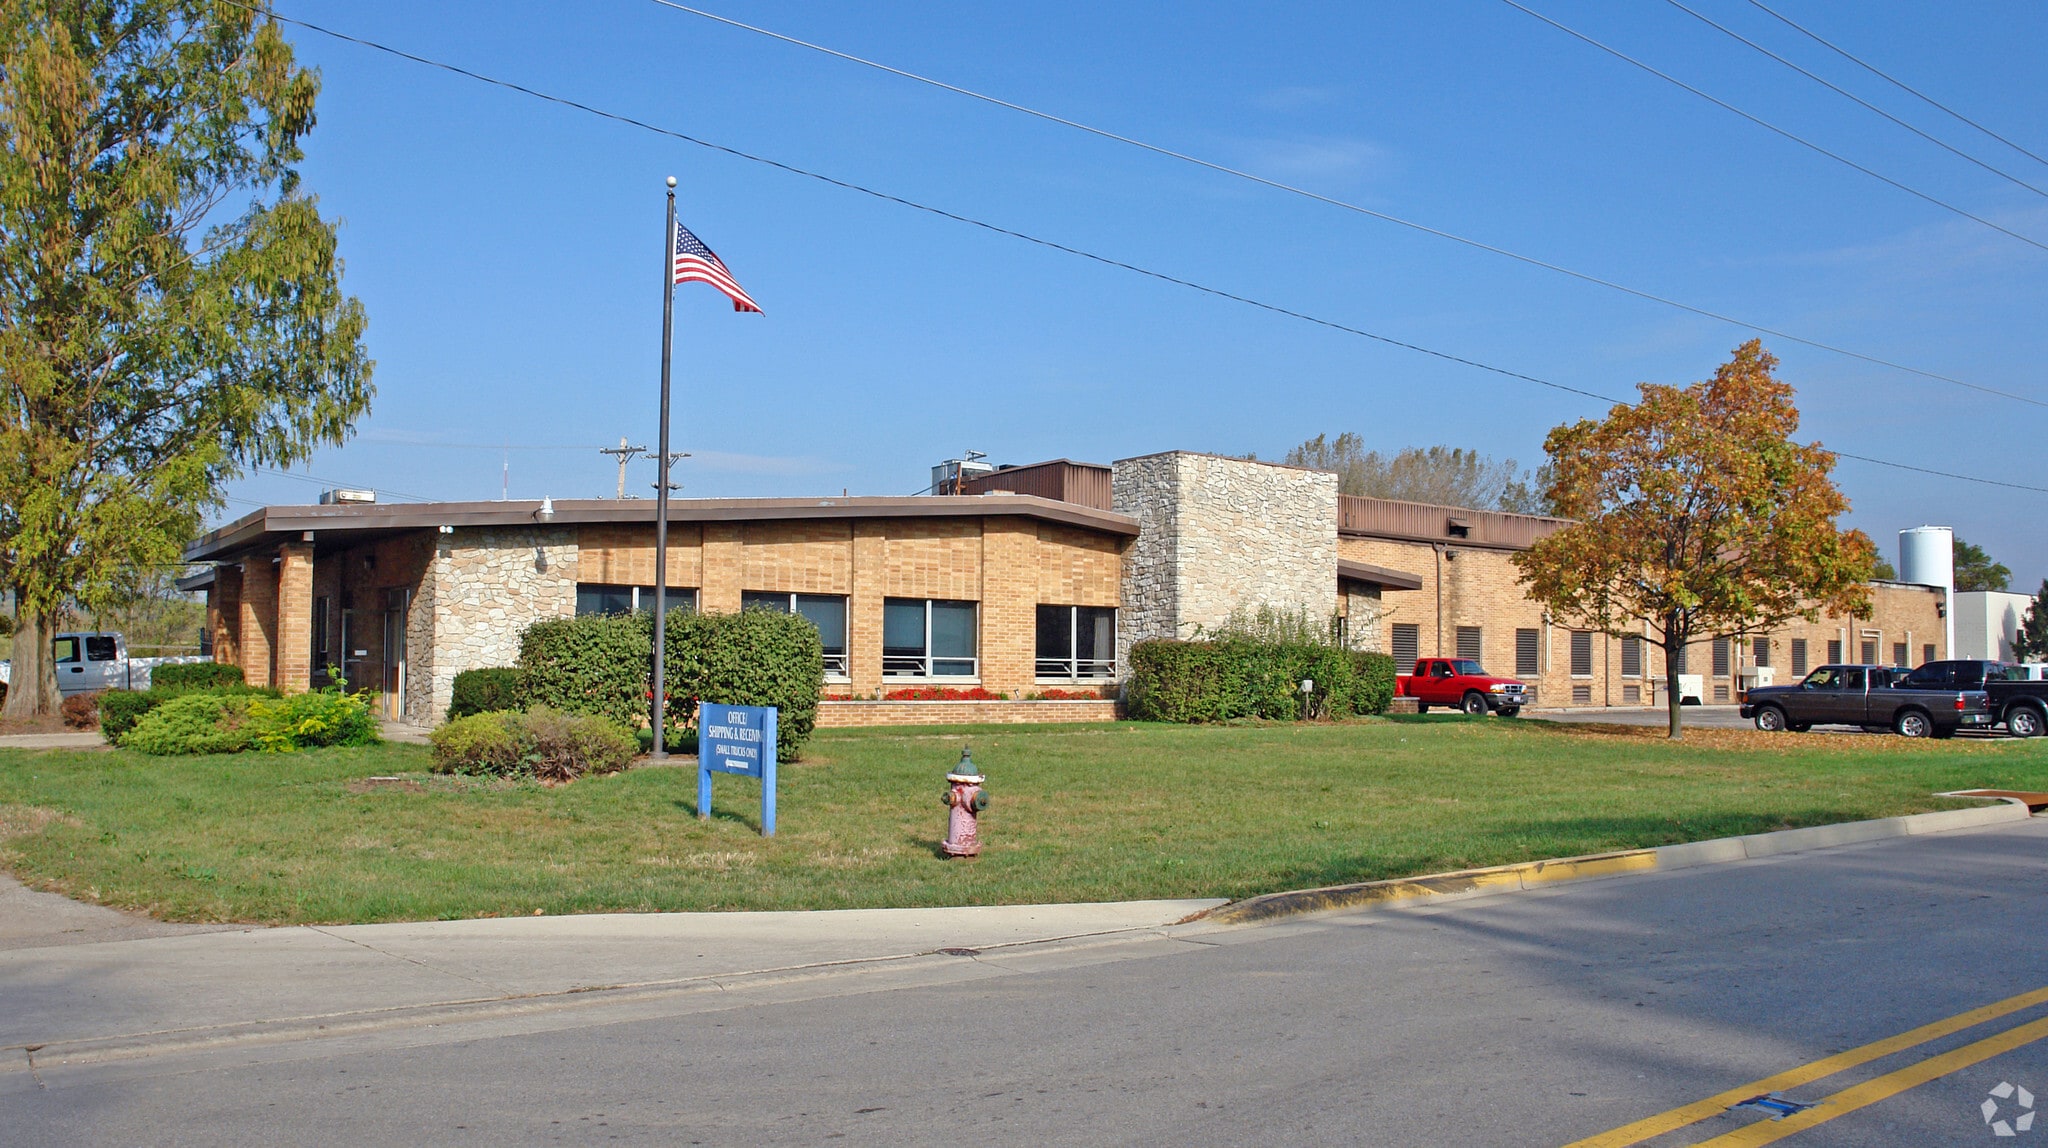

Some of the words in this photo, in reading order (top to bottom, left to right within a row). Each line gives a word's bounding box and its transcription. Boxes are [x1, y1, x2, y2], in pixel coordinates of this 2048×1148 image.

[708, 725, 734, 740] SHIPPING
[734, 727, 739, 740] &
[740, 728, 762, 742] RECEIVIN
[716, 744, 730, 756] (SMALL
[730, 745, 746, 757] TRUCKS
